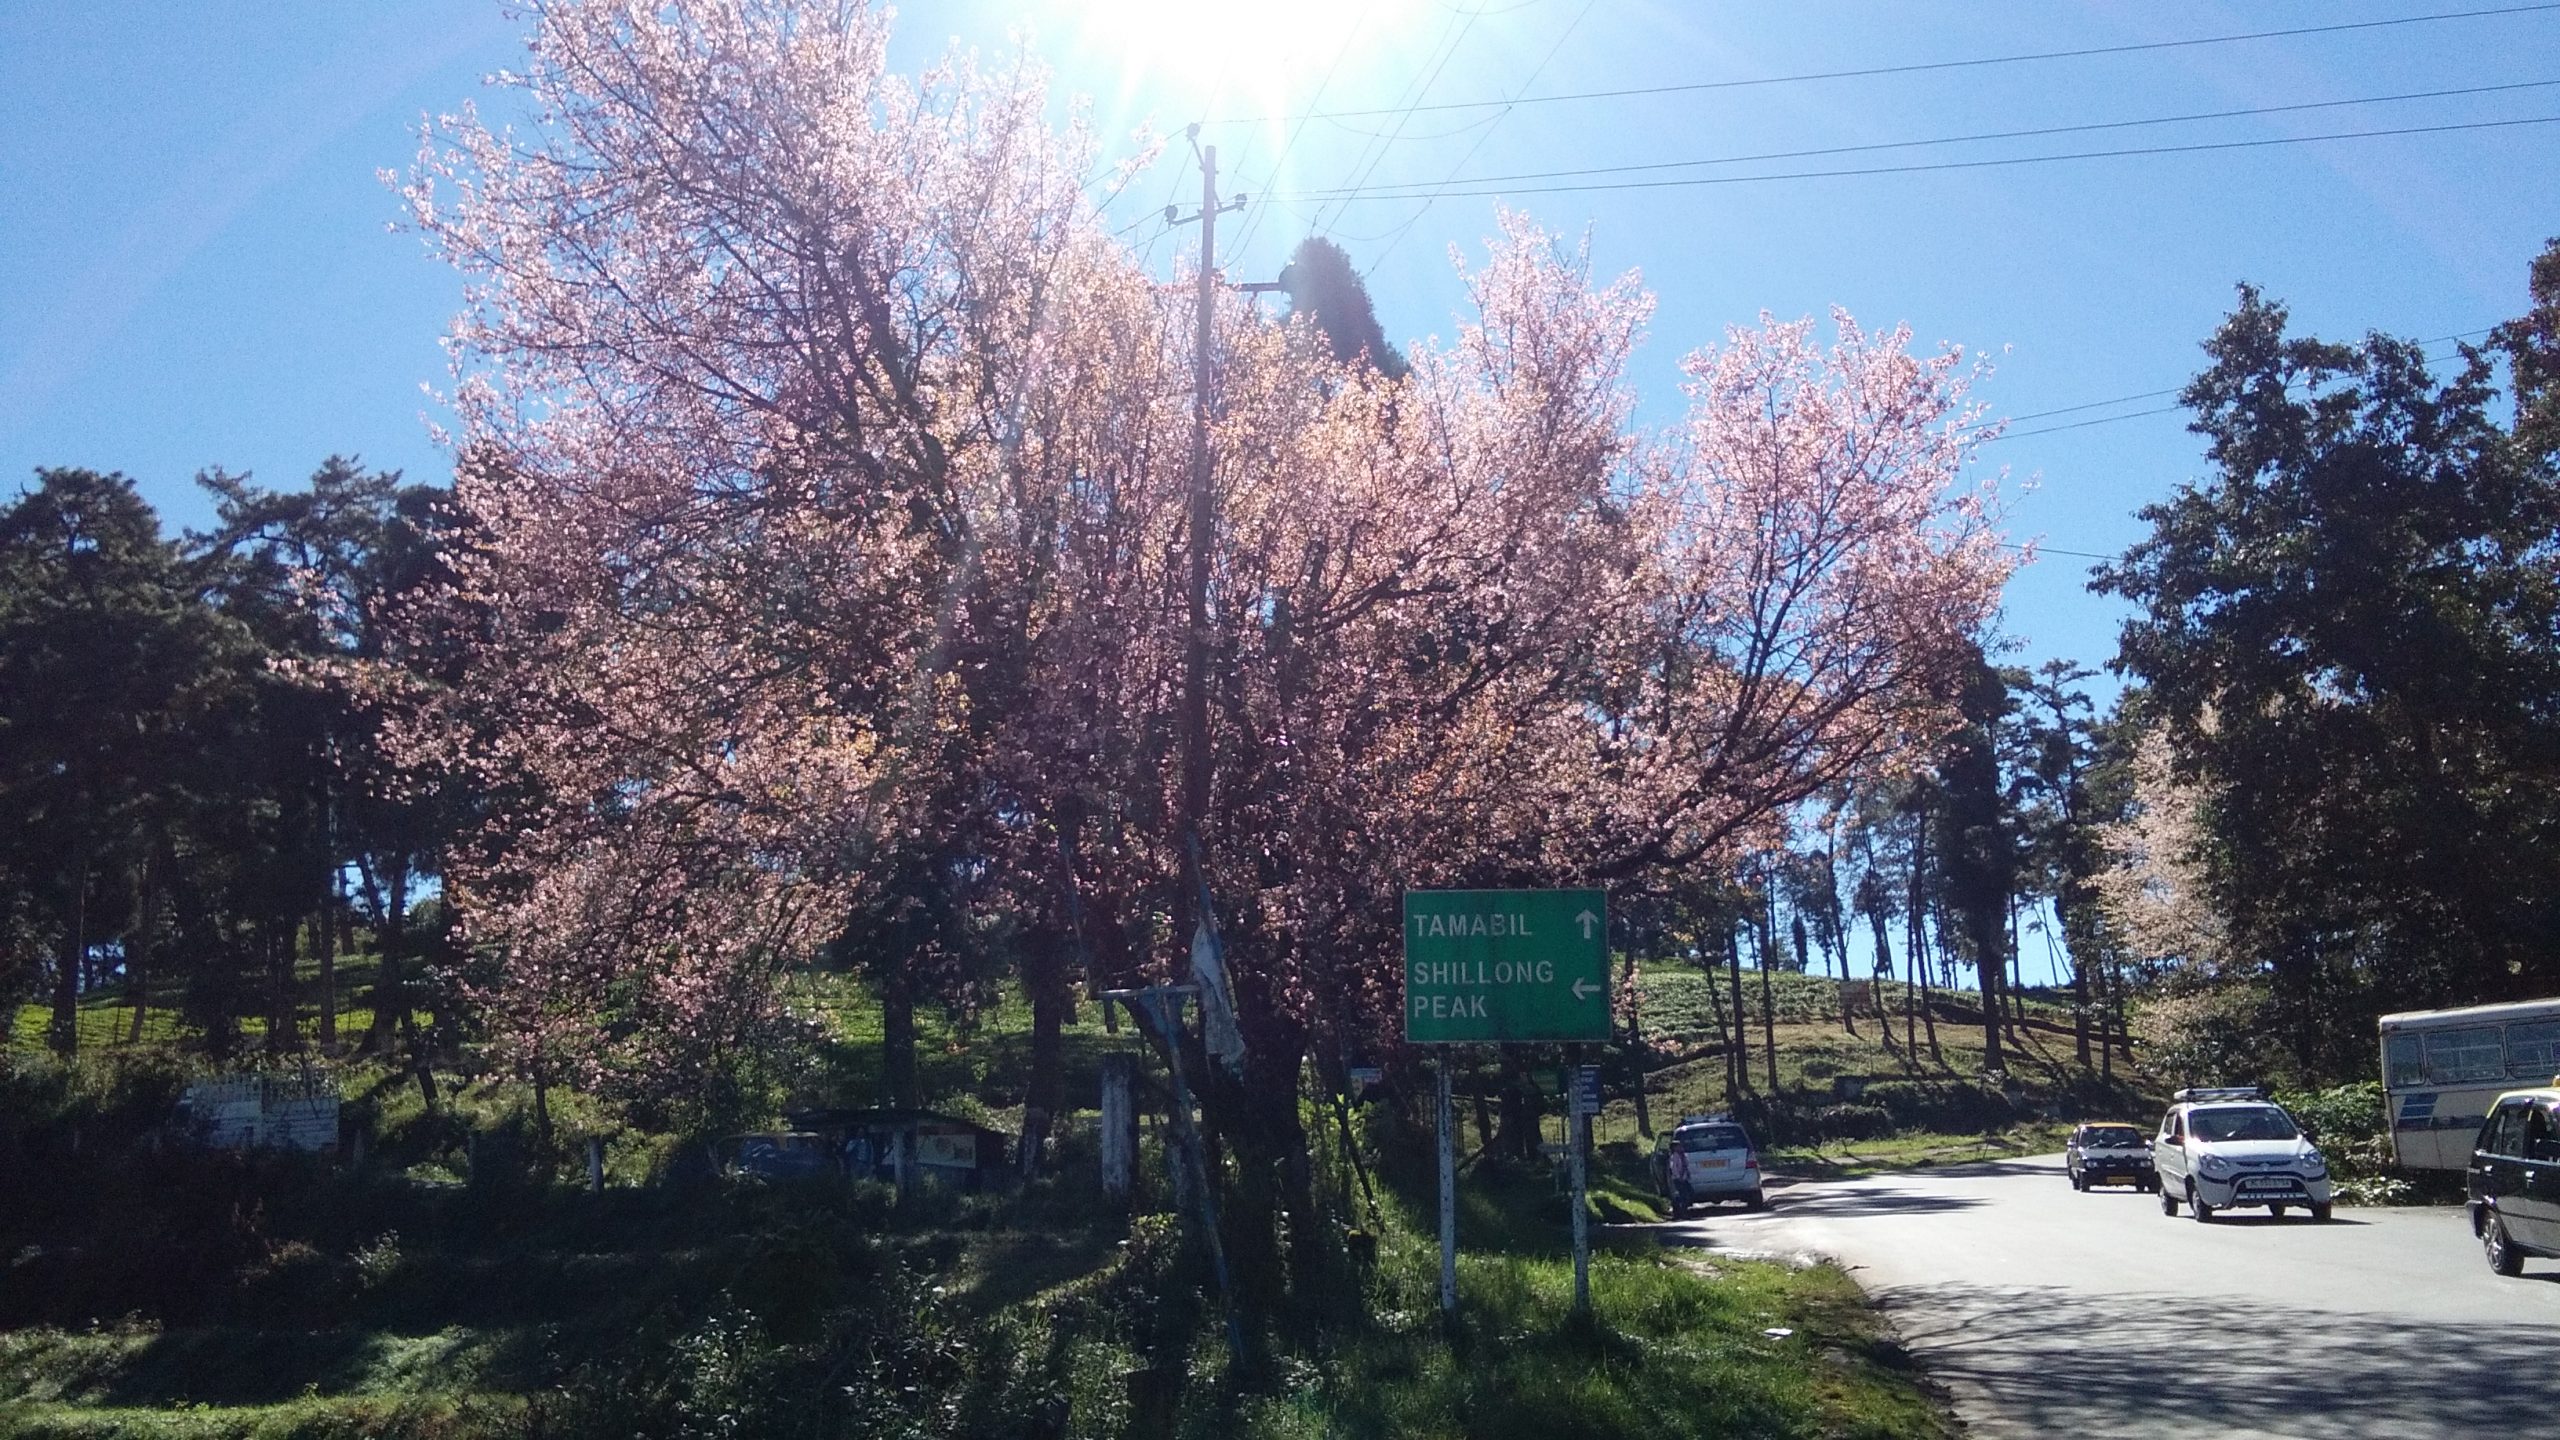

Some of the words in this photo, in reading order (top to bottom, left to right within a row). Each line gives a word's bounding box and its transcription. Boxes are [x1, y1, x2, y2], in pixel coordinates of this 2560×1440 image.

[1413, 913, 1532, 937] TAMABIL
[1413, 960, 1554, 985] SHILLONG
[1414, 995, 1488, 1018] PEAK
